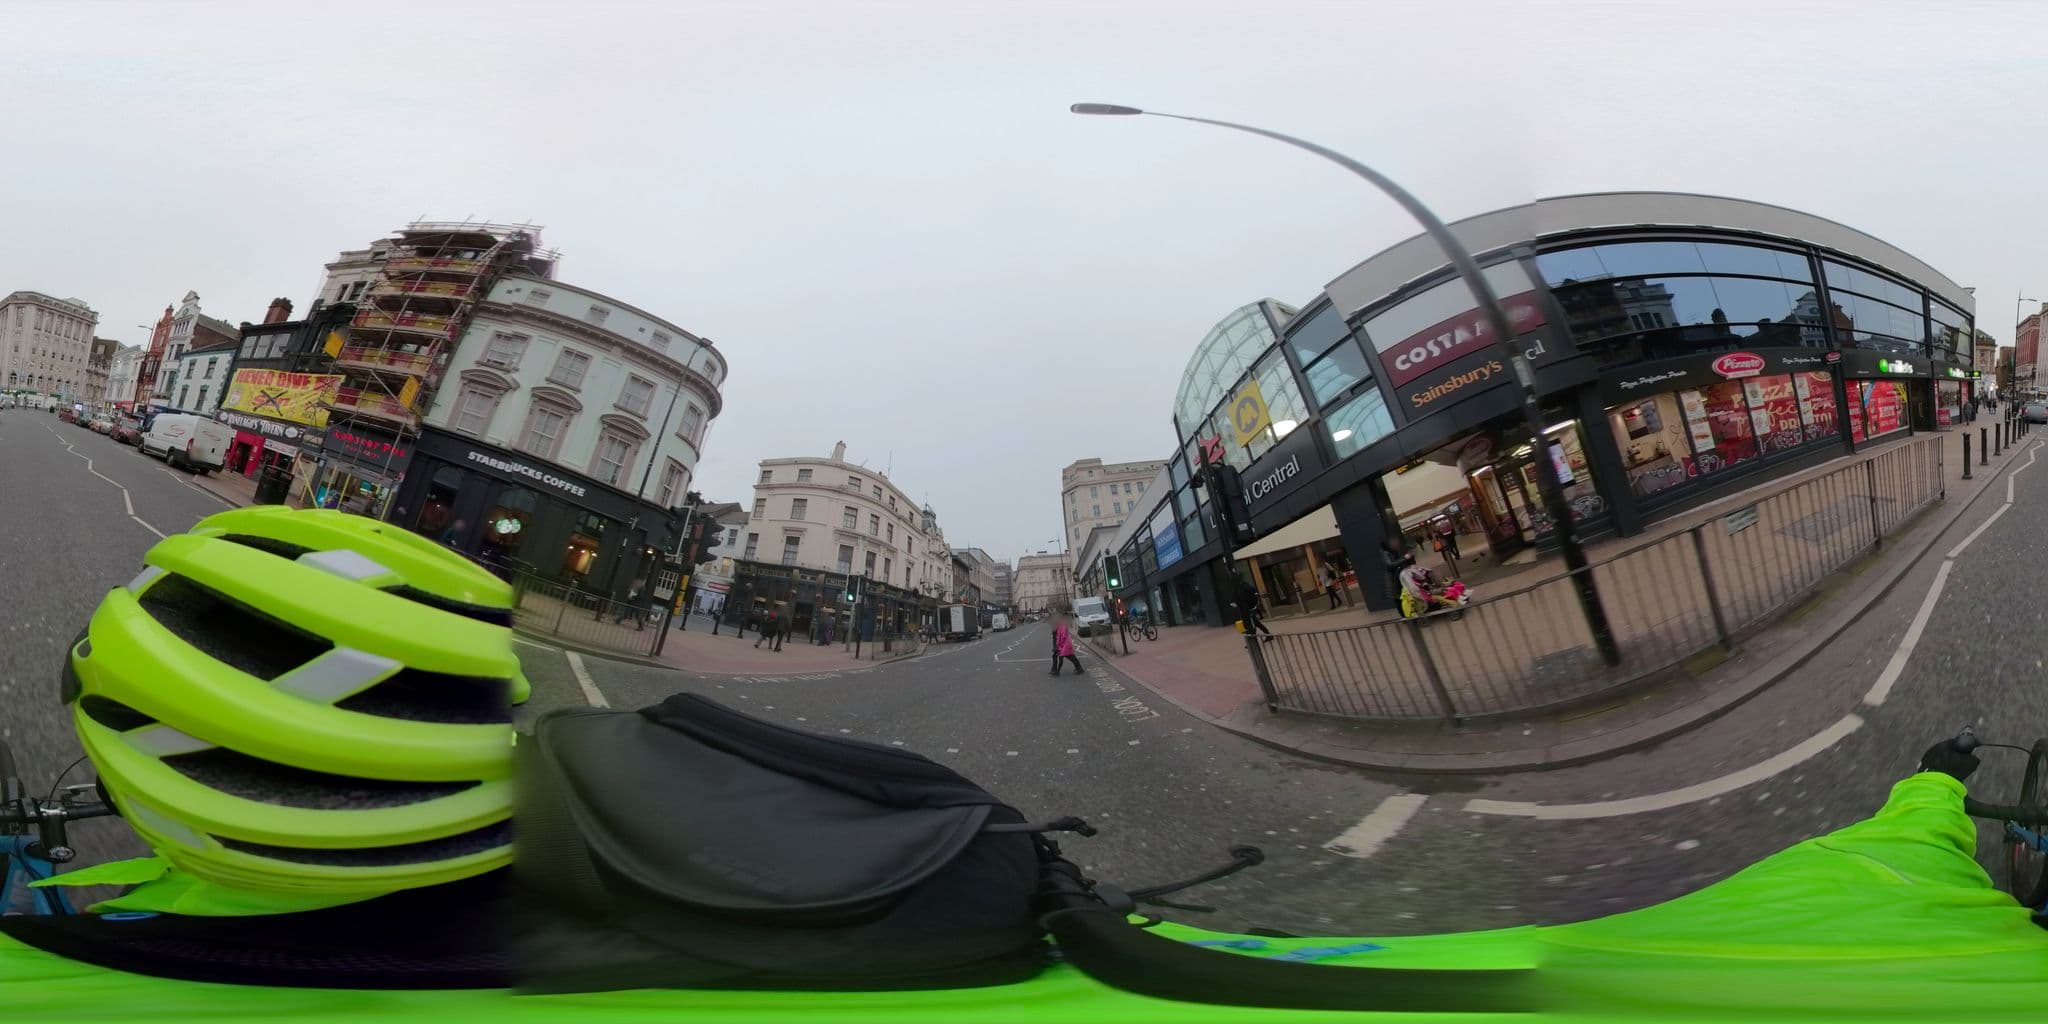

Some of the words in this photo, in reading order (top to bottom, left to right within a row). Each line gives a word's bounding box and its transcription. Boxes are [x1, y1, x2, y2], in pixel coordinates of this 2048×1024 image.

[1395, 328, 1472, 371] COSTA
[1411, 360, 1502, 407] Sainsbury's
[468, 451, 543, 480] STARBUCKS
[543, 475, 586, 497] COFFEE
[1252, 455, 1300, 499] Central
